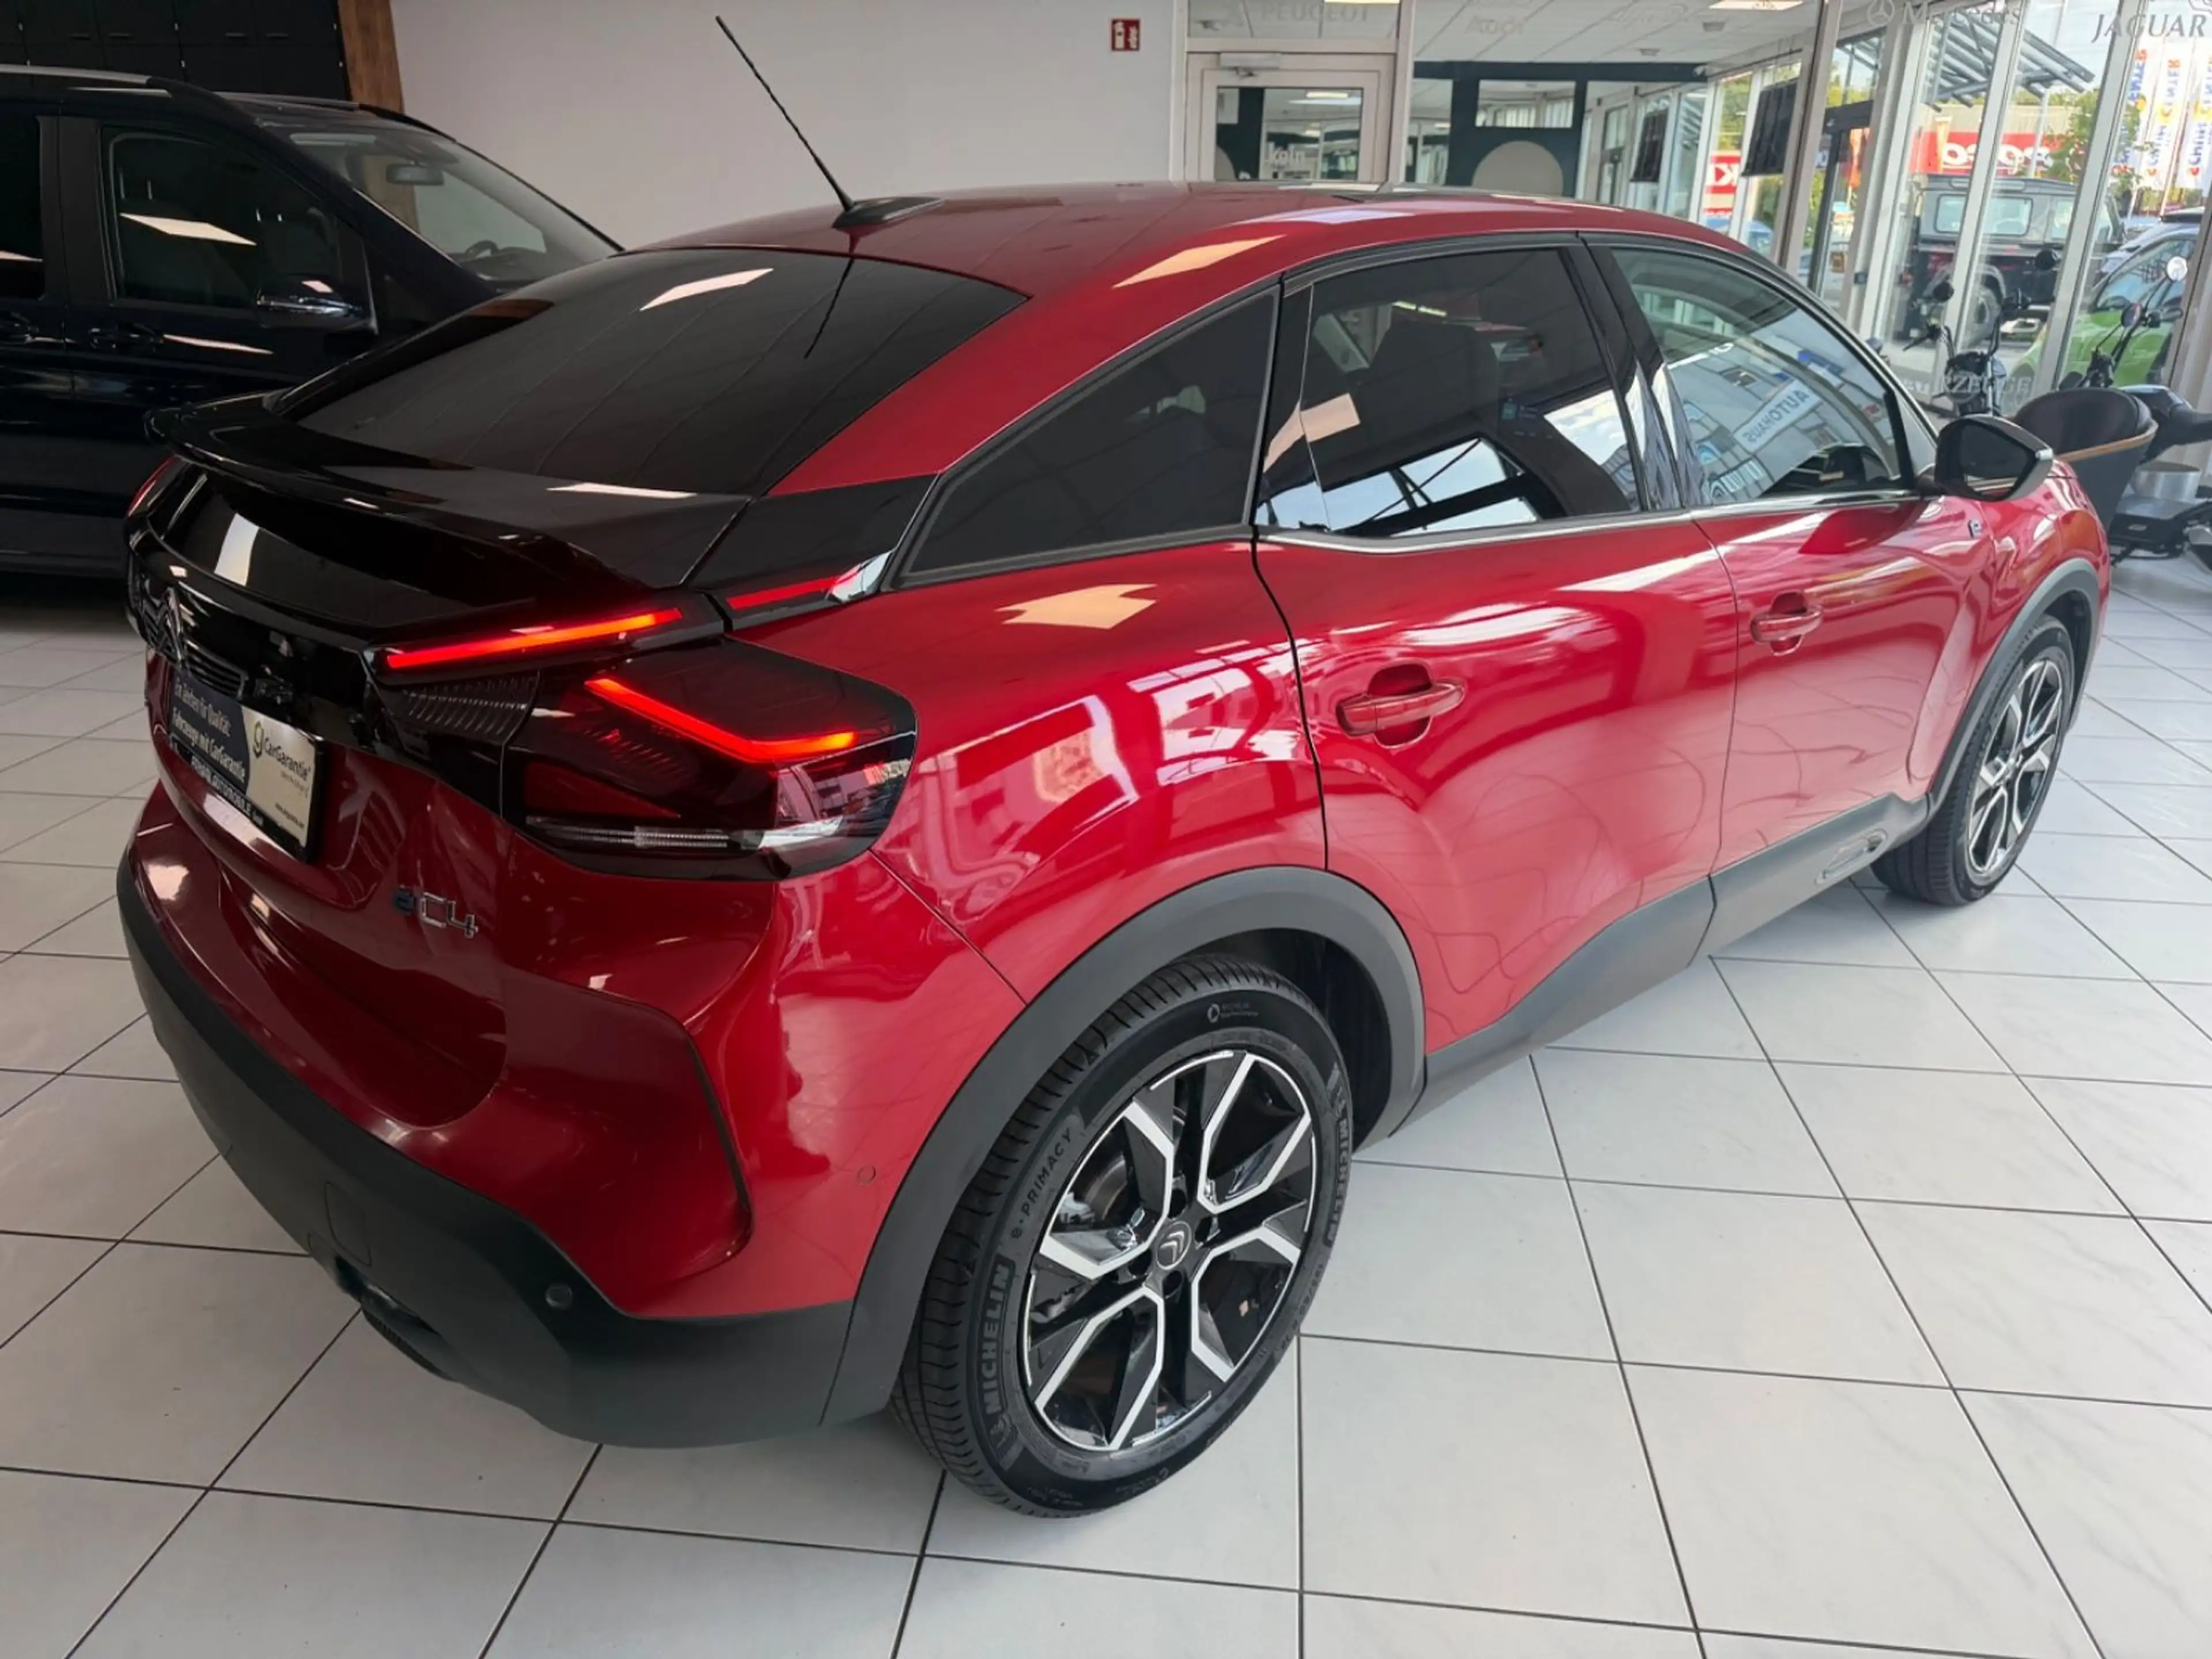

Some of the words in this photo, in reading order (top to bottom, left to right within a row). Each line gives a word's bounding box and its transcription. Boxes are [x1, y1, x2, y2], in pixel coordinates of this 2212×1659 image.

[1262, 3, 1369, 22] PEUGEOT
[2091, 14, 2206, 43] JAGUAR
[980, 1263, 1009, 1415] MICHELIN
